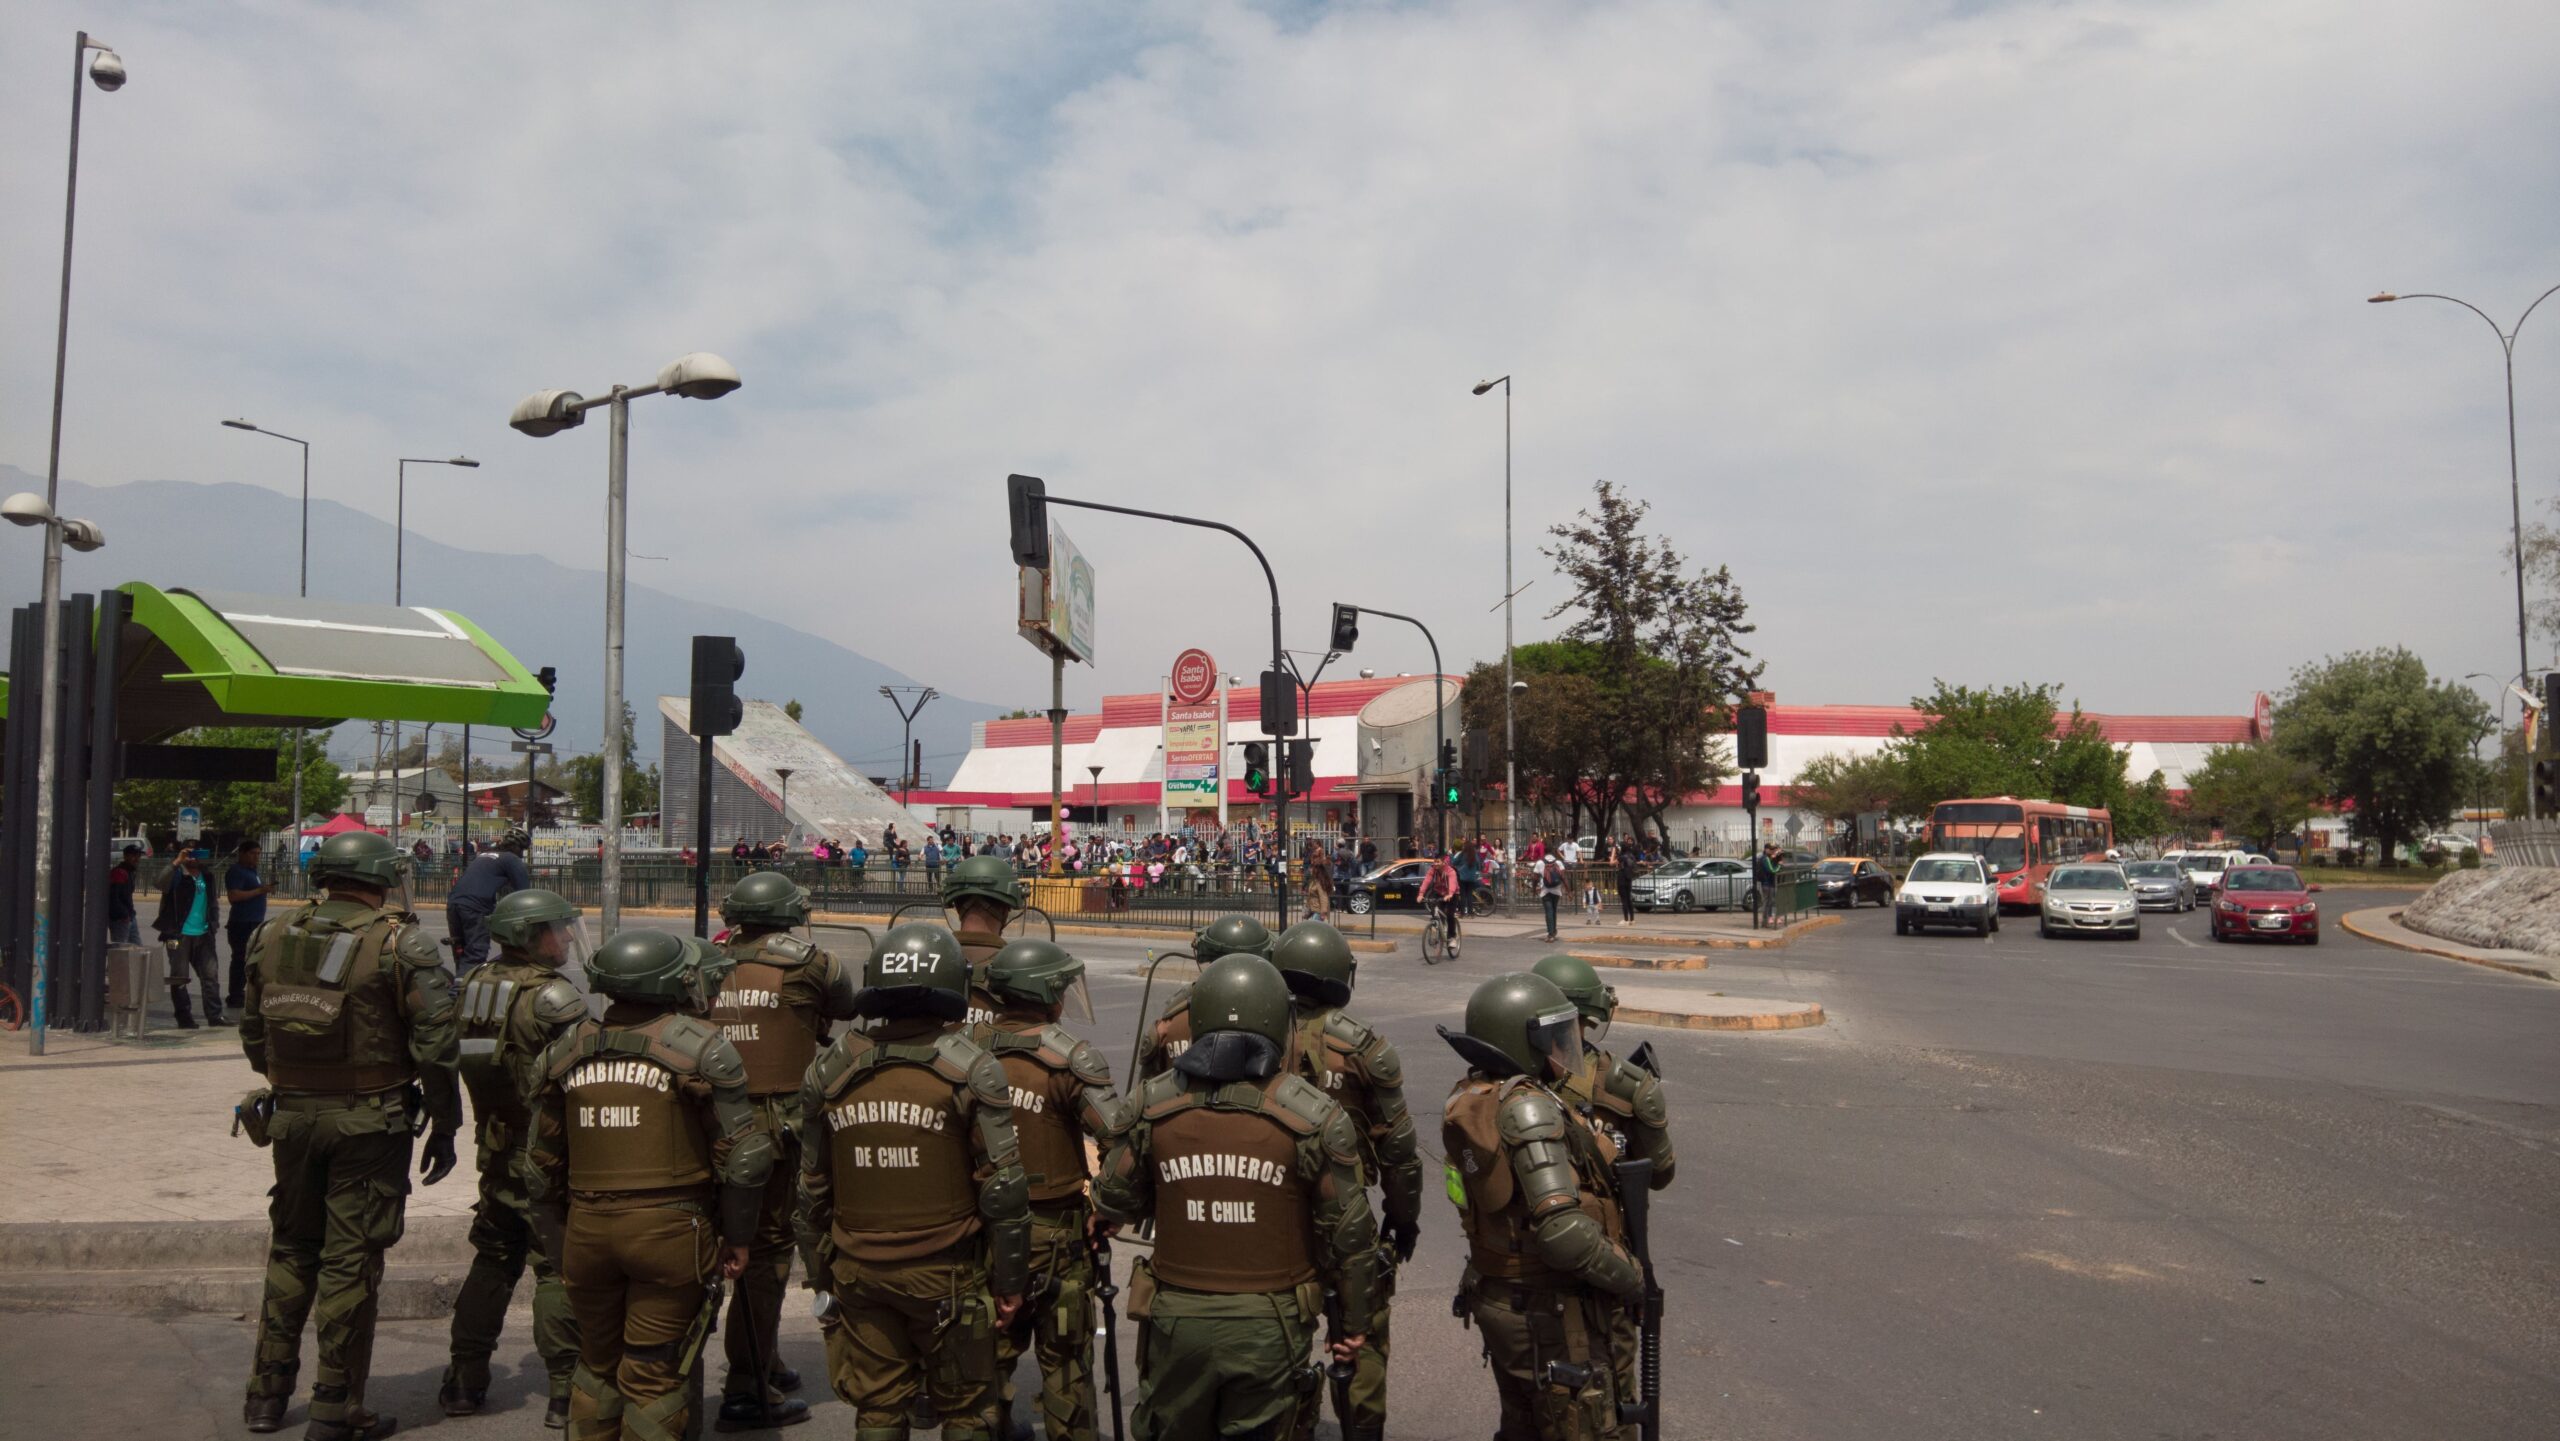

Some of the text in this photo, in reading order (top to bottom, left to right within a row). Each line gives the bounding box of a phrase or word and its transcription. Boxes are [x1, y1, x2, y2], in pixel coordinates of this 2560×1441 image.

[1180, 673, 1204, 683] Isabel
[1182, 665, 1205, 674] Santa
[1171, 709, 1215, 720] Santa Isabel
[882, 952, 941, 974] E21-7
[263, 993, 310, 1008] CARABINEROS
[723, 1023, 760, 1041] CHILE
[580, 1106, 640, 1127] DE CHILE
[827, 1100, 947, 1132] CARABINEROS
[854, 1146, 920, 1168] DE CHILE
[1159, 1154, 1287, 1186] CARABINEROS
[1186, 1199, 1256, 1223] DE CHILE
